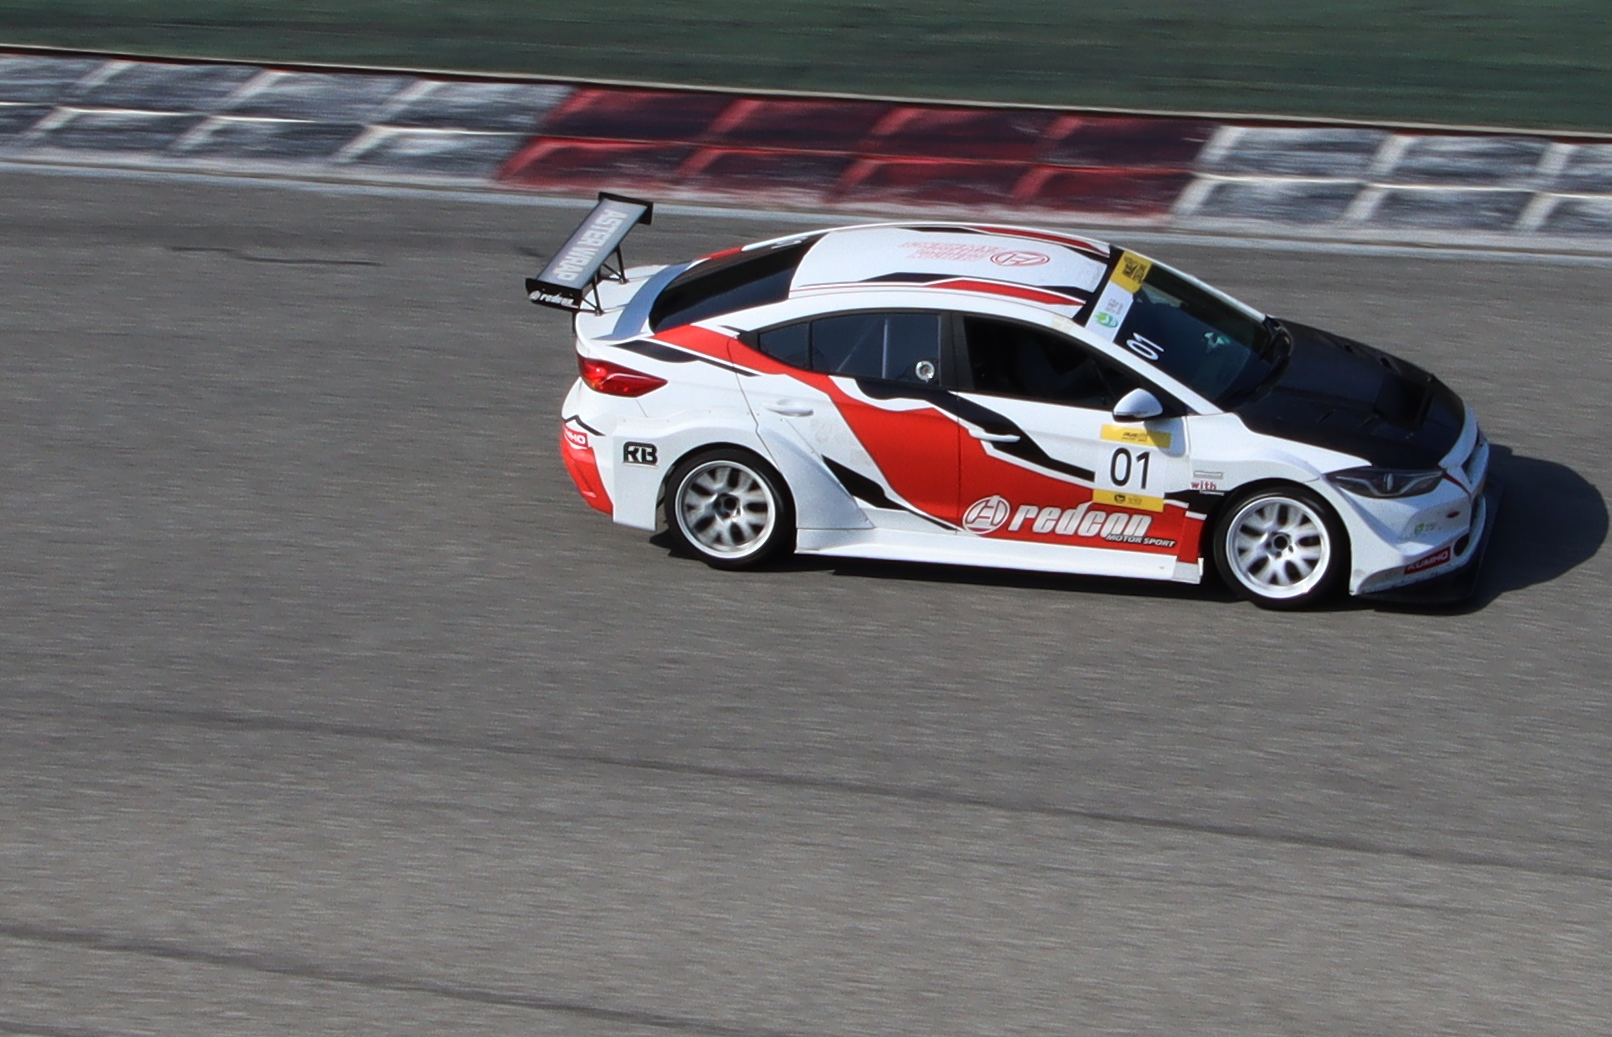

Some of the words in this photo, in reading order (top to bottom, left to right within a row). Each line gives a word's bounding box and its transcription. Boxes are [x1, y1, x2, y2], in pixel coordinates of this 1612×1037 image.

[577, 208, 628, 247] ASTER
[552, 246, 599, 281] WRAP
[1126, 331, 1165, 360] 01
[623, 441, 658, 466] RB
[1110, 447, 1151, 490] 01
[1007, 500, 1153, 538] redcon
[1104, 534, 1142, 545] MOTOR
[1143, 538, 1177, 548] SPORT
